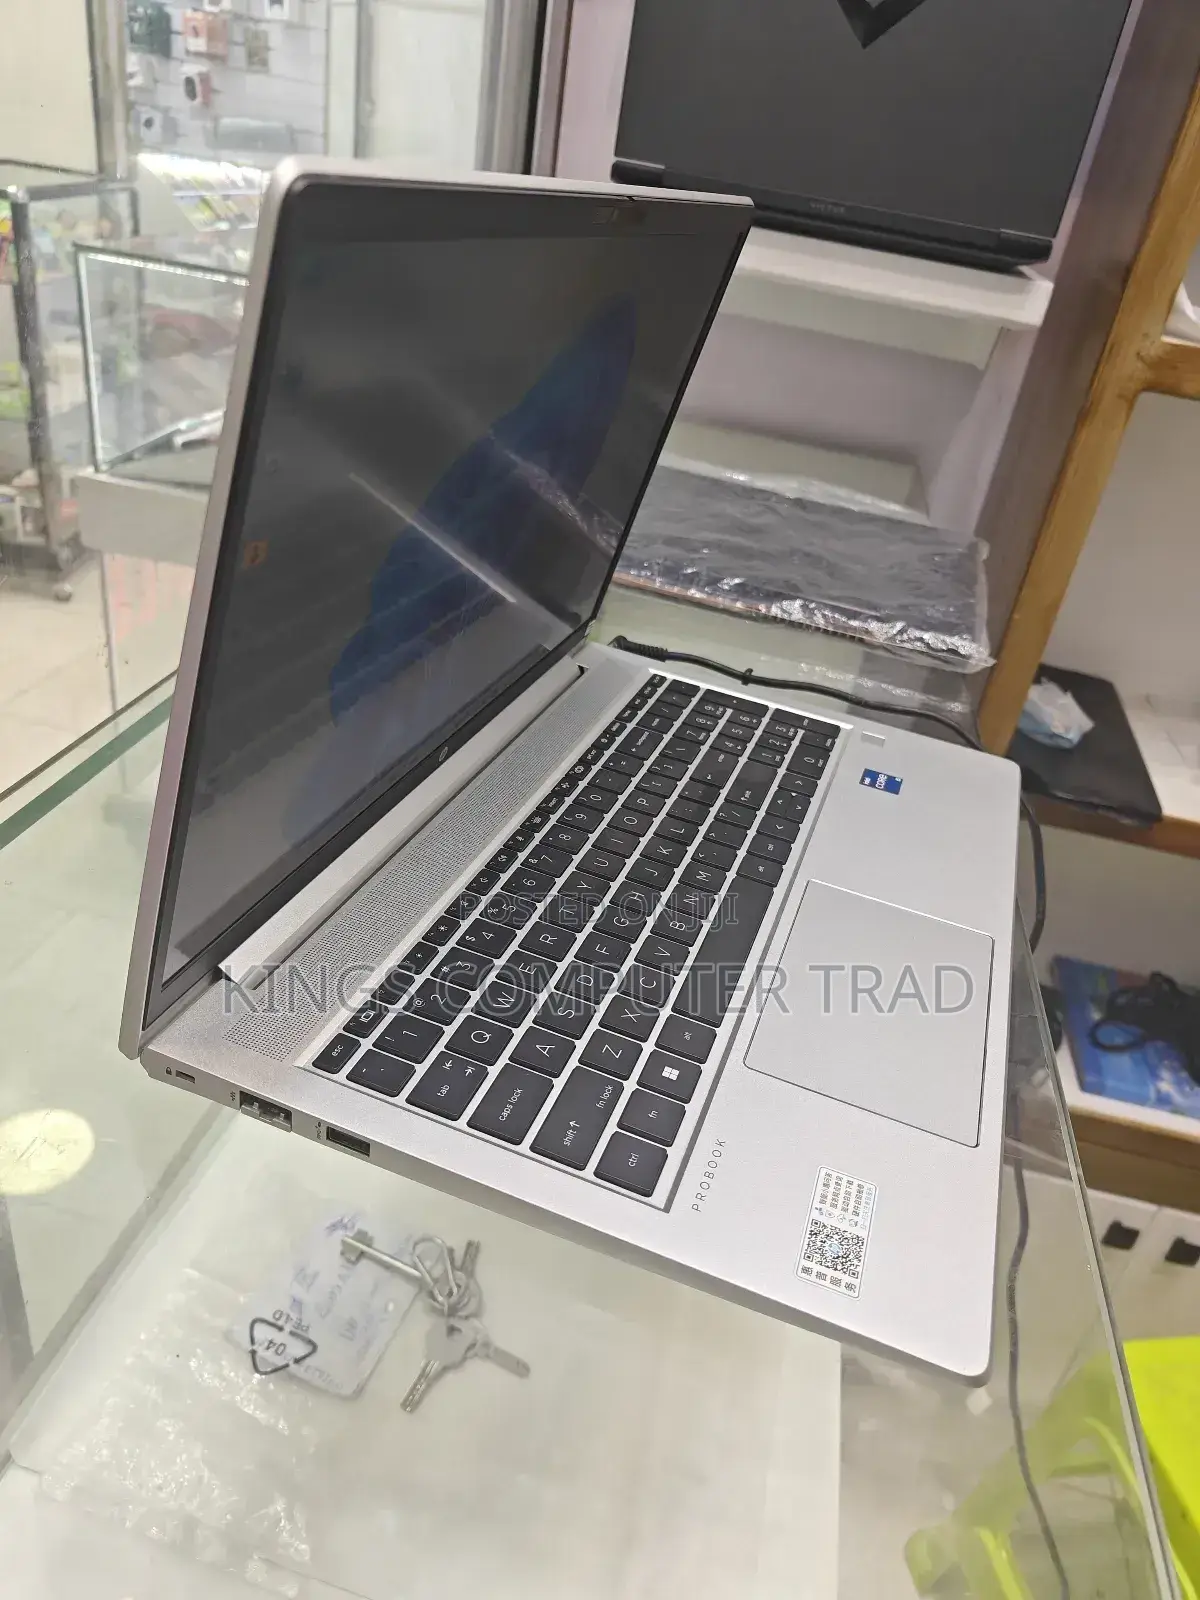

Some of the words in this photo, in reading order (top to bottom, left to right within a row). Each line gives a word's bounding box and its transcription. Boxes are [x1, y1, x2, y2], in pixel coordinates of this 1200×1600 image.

[430, 994, 447, 1005] 2
[455, 960, 471, 971] 3
[481, 931, 495, 940] 4
[501, 903, 517, 913] 5
[522, 878, 536, 886] 6
[540, 854, 553, 863] 7
[558, 833, 572, 841] 8
[470, 1030, 492, 1044] Q
[492, 991, 515, 1008] W
[518, 962, 537, 975] E
[539, 933, 558, 945] R
[558, 905, 575, 915] T
[576, 880, 592, 889] Y
[593, 857, 609, 867] U
[623, 816, 638, 825] O
[636, 797, 649, 806] P
[535, 1044, 556, 1058] A
[557, 1006, 575, 1019] S
[576, 974, 594, 987] D
[595, 943, 610, 955] F
[613, 916, 630, 927] G
[628, 890, 645, 902] H
[644, 867, 658, 877] J
[656, 845, 673, 855] K
[670, 826, 686, 835] L
[601, 1044, 623, 1059] Z
[620, 1008, 641, 1023] X
[639, 976, 657, 989] C
[654, 946, 671, 956] V
[669, 920, 686, 931] B
[683, 894, 700, 906] N
[695, 870, 712, 882] M
[331, 1044, 344, 1057] esc
[436, 1084, 450, 1097] tab
[599, 1084, 614, 1100] lock
[498, 1103, 514, 1121] caps
[507, 1087, 523, 1104] lock
[595, 1100, 606, 1109] fn
[647, 1110, 659, 1119] fn
[563, 1129, 577, 1147] shift
[628, 1152, 639, 1167] ctrl
[691, 1138, 726, 1213] PROBOOK
[800, 1264, 857, 1293] 惠普服务
[265, 1338, 287, 1357] 04
